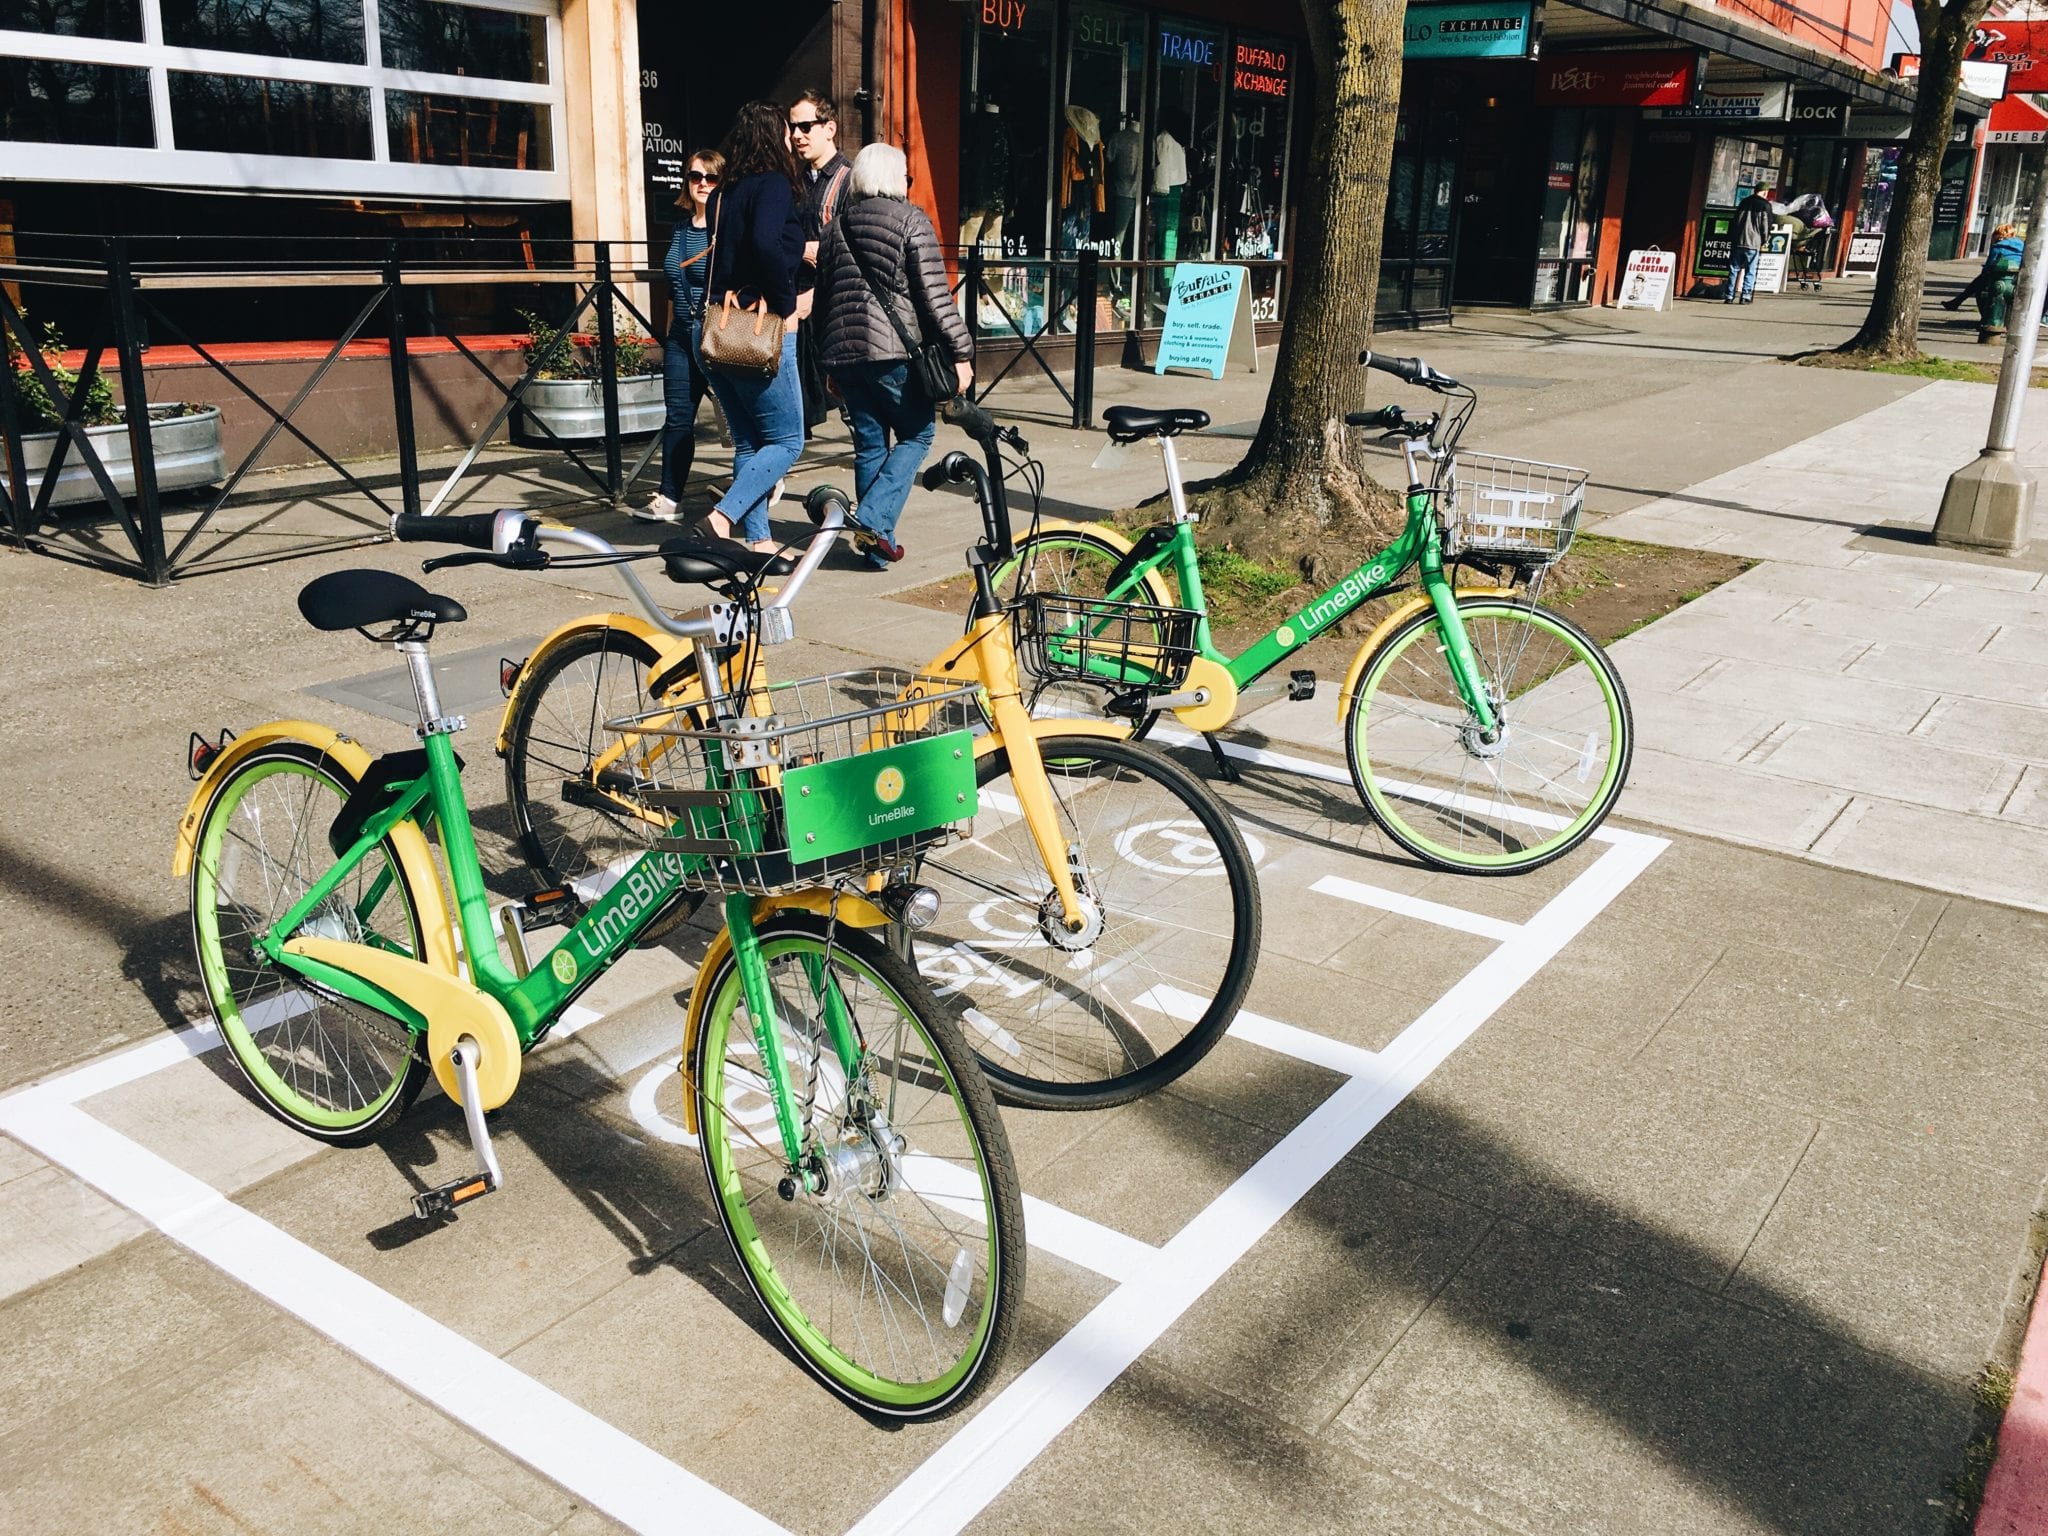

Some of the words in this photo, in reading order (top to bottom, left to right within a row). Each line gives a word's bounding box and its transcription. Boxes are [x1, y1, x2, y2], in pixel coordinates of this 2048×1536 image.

[982, 0, 1026, 29] BUY
[1080, 15, 1126, 47] SELL
[1439, 18, 1521, 33] EXCHANGE
[1160, 32, 1215, 66] TRADE
[1236, 45, 1287, 72] BUFFALO
[639, 69, 658, 88] 36
[1722, 97, 1761, 107] FAMILY
[1669, 108, 1753, 116] INSURANCE
[1791, 106, 1838, 119] LOCK
[1994, 132, 2019, 142] PIE
[1705, 240, 1732, 250] WE'RE
[1641, 255, 1662, 265] AUTO
[1703, 250, 1731, 260] OPEN
[1628, 263, 1670, 274] LICENSING
[1169, 354, 1190, 363] buying
[1201, 357, 1213, 365] day
[1299, 564, 1386, 631] LimeBike
[410, 608, 437, 619] LimeBike
[868, 805, 915, 827] LimeBike
[577, 850, 685, 957] LimeBike
